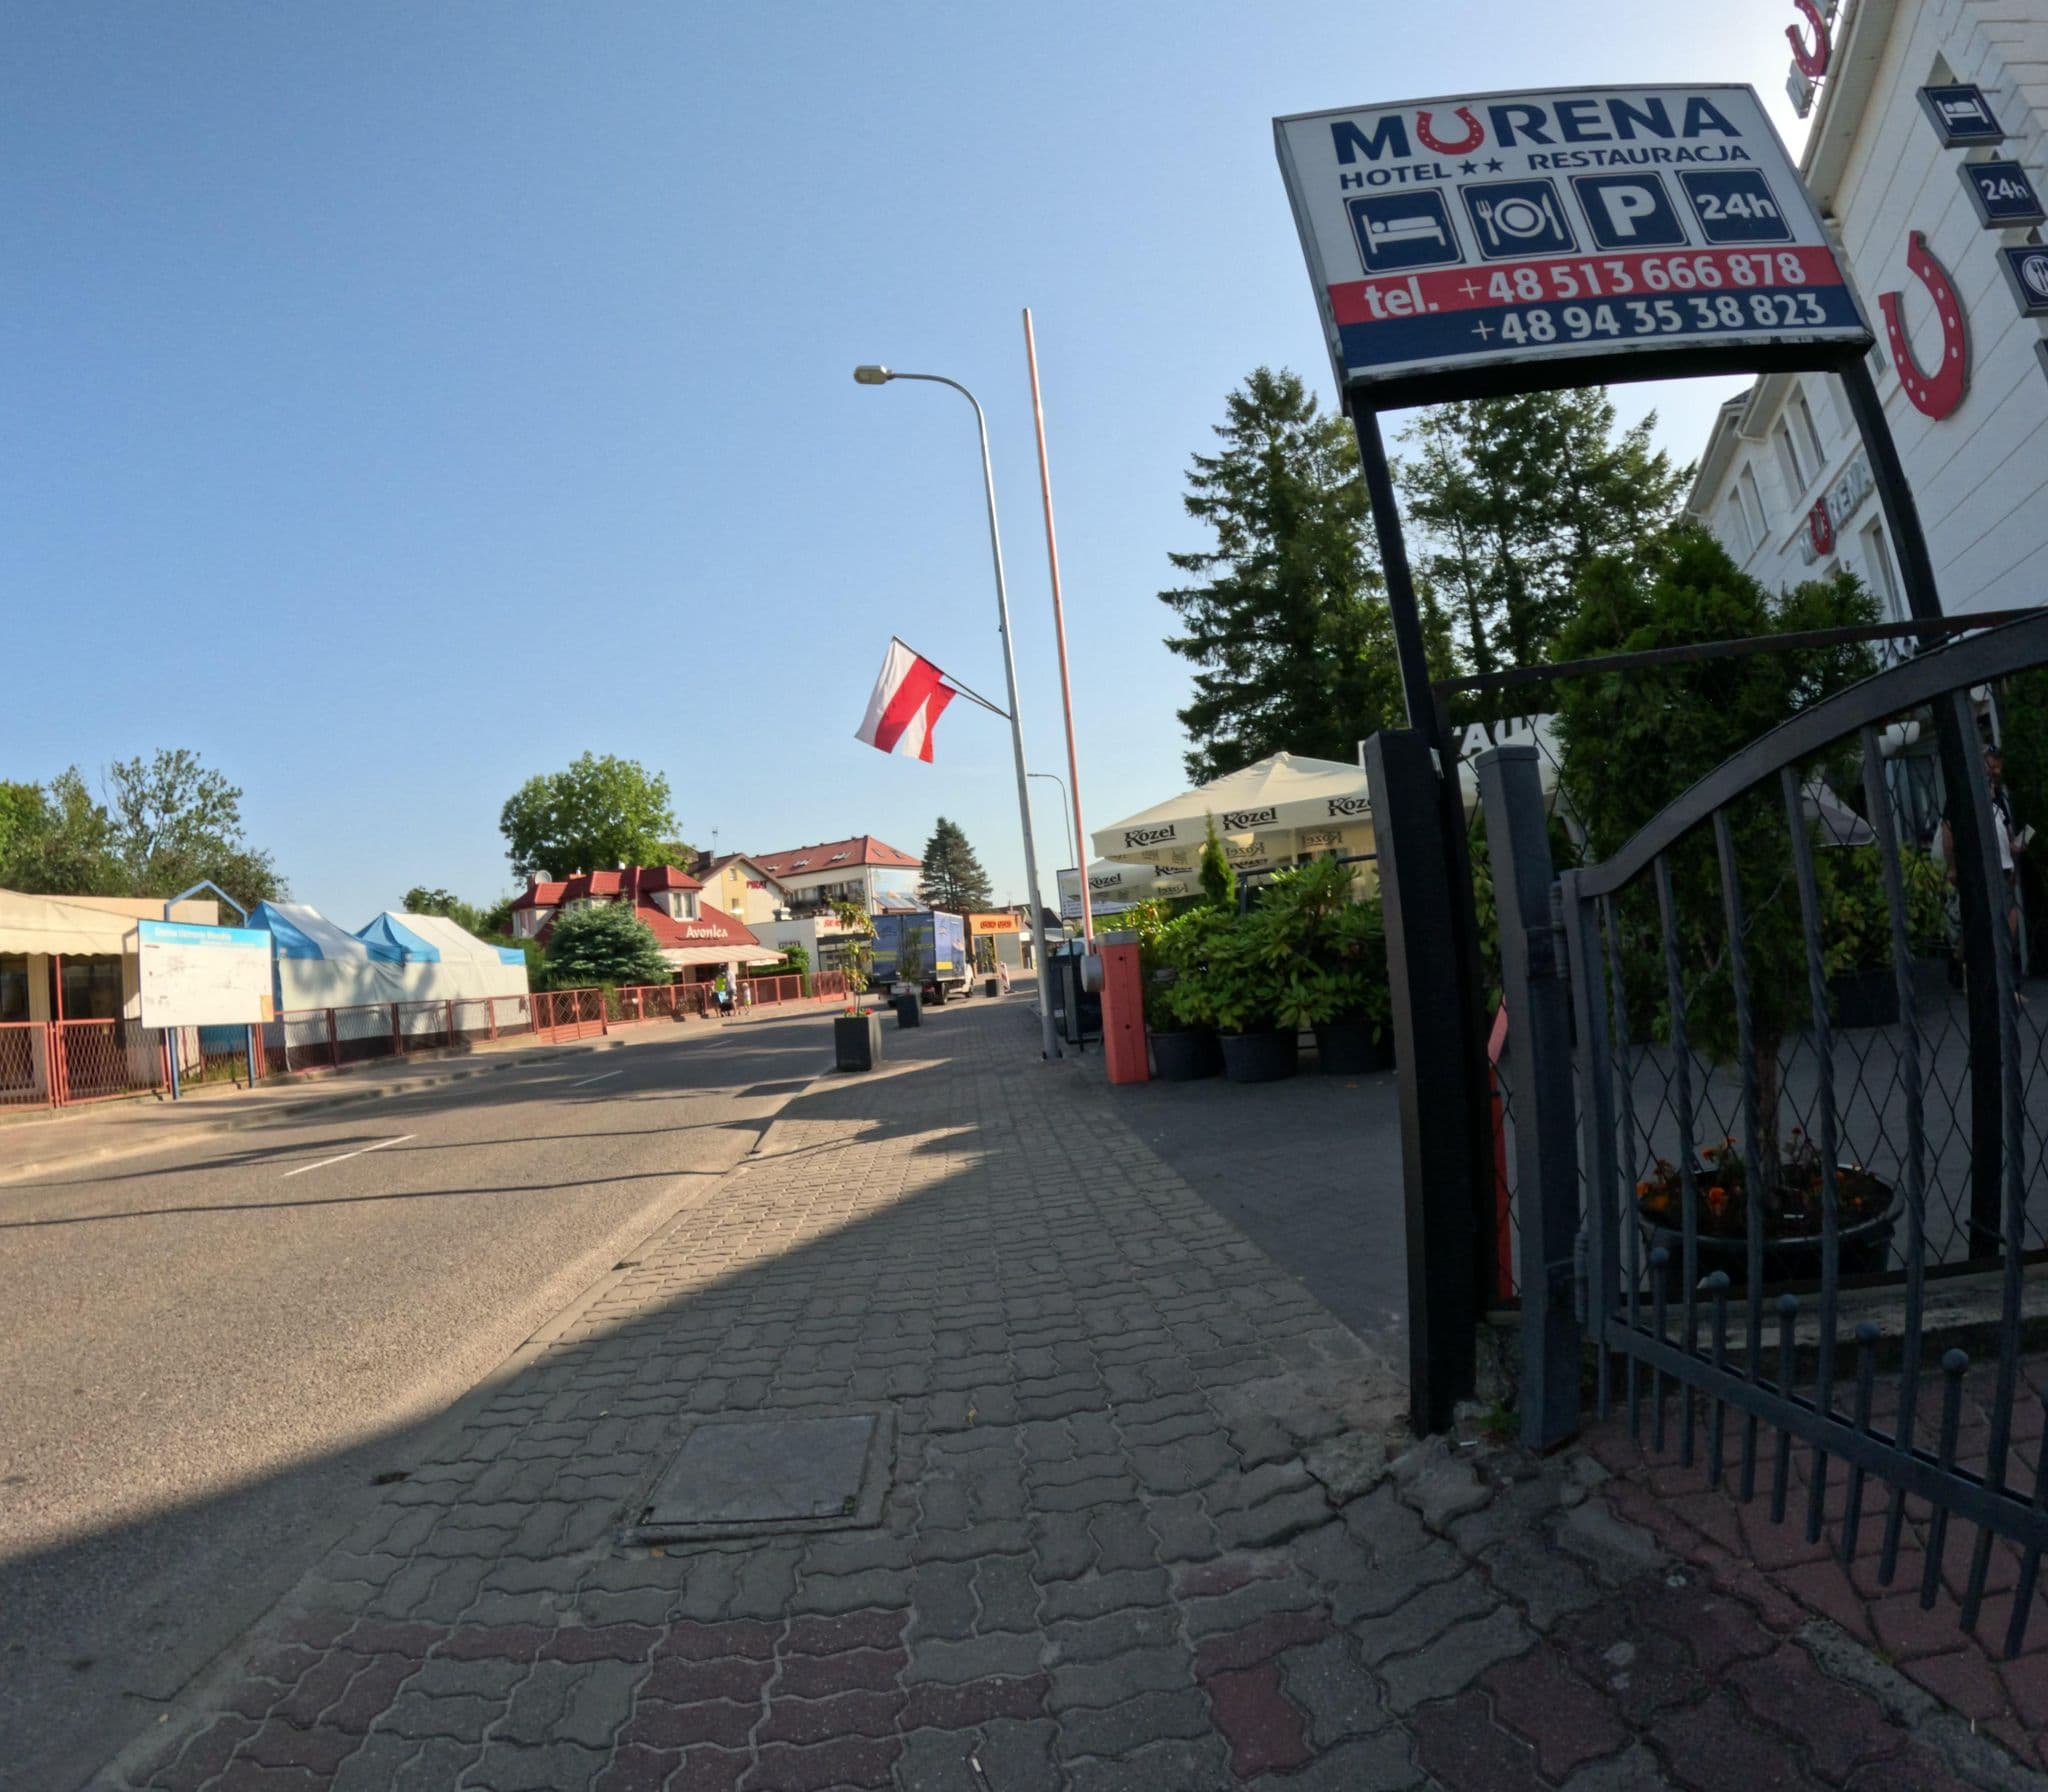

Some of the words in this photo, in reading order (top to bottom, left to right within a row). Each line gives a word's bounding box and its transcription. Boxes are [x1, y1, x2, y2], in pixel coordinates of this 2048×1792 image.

[1339, 163, 1452, 191] HOTEL
[1527, 145, 1752, 171] RESTAURACJA
[1980, 178, 2030, 201] 24h
[1598, 185, 1657, 237] P
[1696, 192, 1778, 220] 24h
[1364, 275, 1440, 320] tel.
[1457, 267, 1544, 304] +48
[1550, 260, 1634, 299] 513
[1640, 255, 1723, 291] 666
[1726, 252, 1806, 286] 878
[1471, 308, 1557, 344] +48
[1562, 303, 1621, 340] 94
[1625, 300, 1683, 334] 35
[1688, 295, 1745, 329] 38
[1749, 292, 1827, 327] 823
[1123, 824, 1177, 848] Kozel
[1223, 806, 1279, 831] Kozel
[686, 924, 729, 939] Avonica
